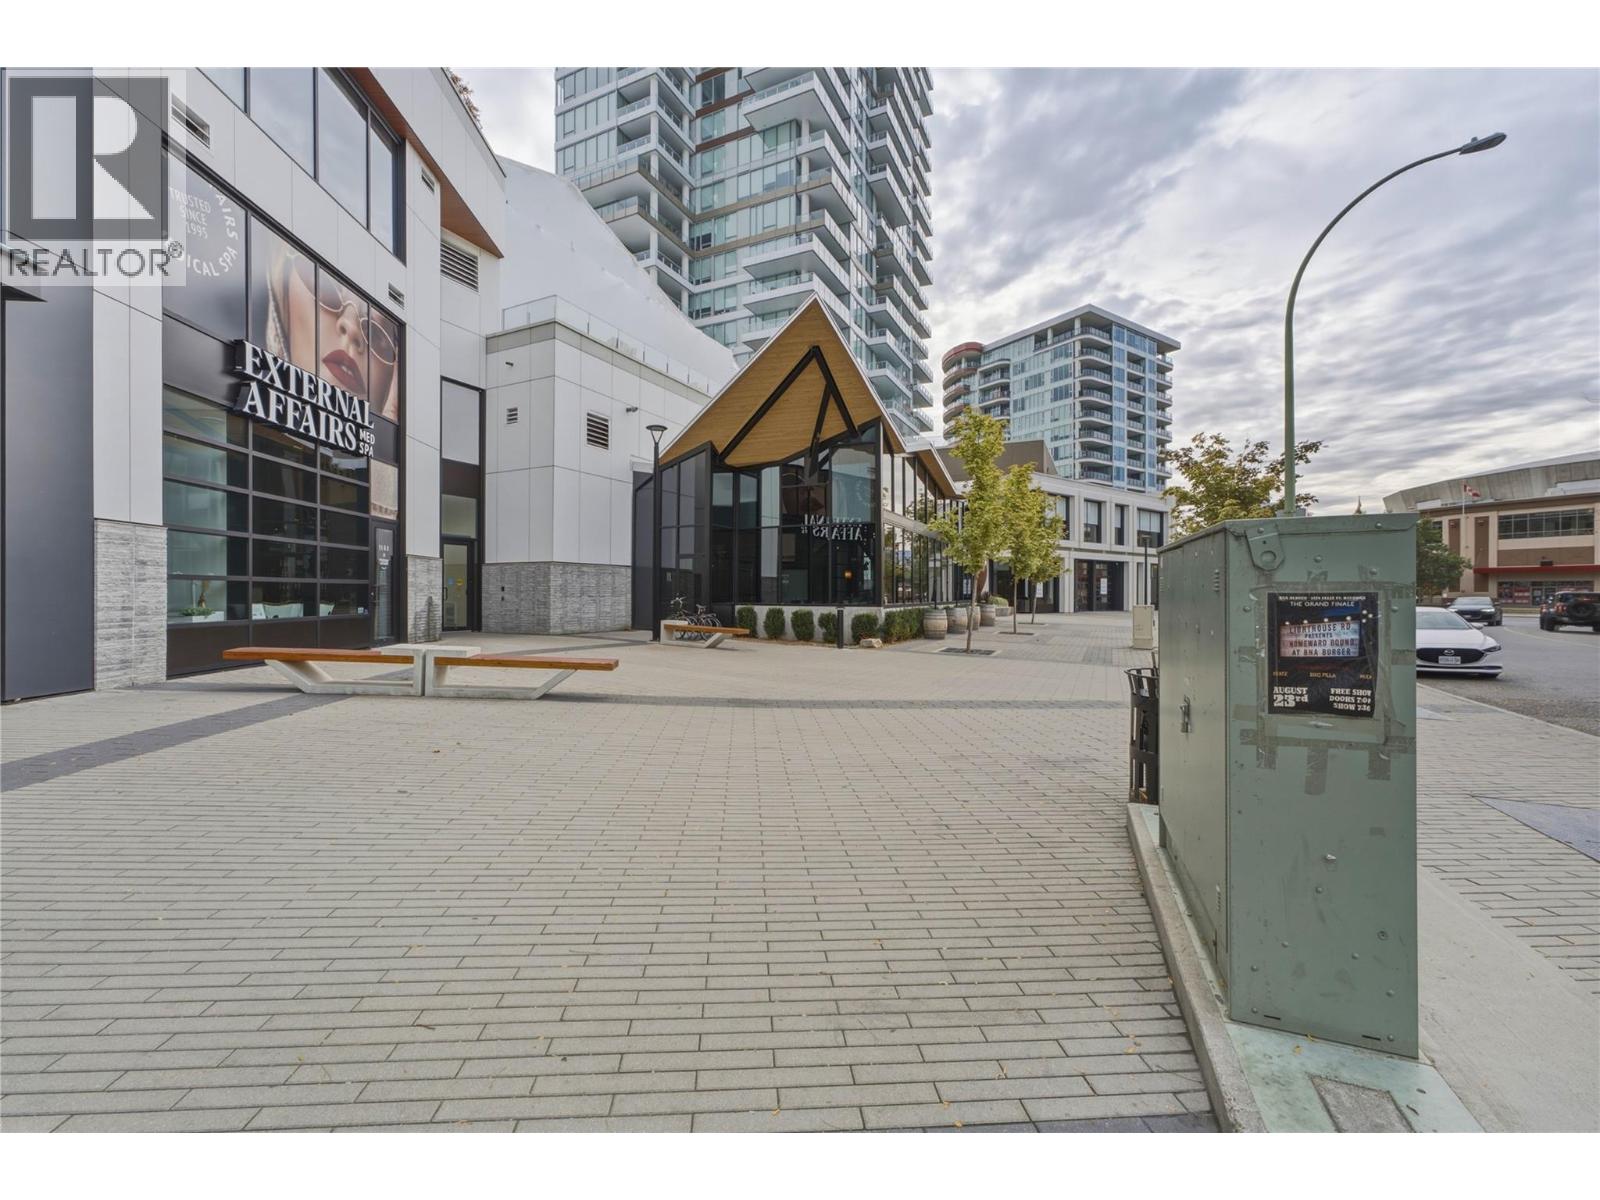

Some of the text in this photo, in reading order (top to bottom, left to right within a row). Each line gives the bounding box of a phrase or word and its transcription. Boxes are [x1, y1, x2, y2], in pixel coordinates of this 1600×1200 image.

[169, 186, 211, 214] TRUSTED
[180, 204, 207, 227] SINCE
[218, 246, 239, 272] SPA
[243, 340, 376, 430] EXTERNAL
[242, 380, 357, 451] AFFAIRS
[359, 429, 376, 444] MED
[358, 443, 375, 458] SPA
[1289, 623, 1337, 635] LIGHTHOUSE
[1289, 639, 1327, 648] HOMEWARD
[1292, 648, 1300, 656] AT
[1322, 648, 1351, 656] BURGER
[1273, 686, 1308, 695] AUGUST
[1330, 687, 1351, 695] FREE
[1273, 694, 1308, 707] 23rd
[1329, 695, 1355, 703] DOORS
[1333, 702, 1356, 711] SHOW
